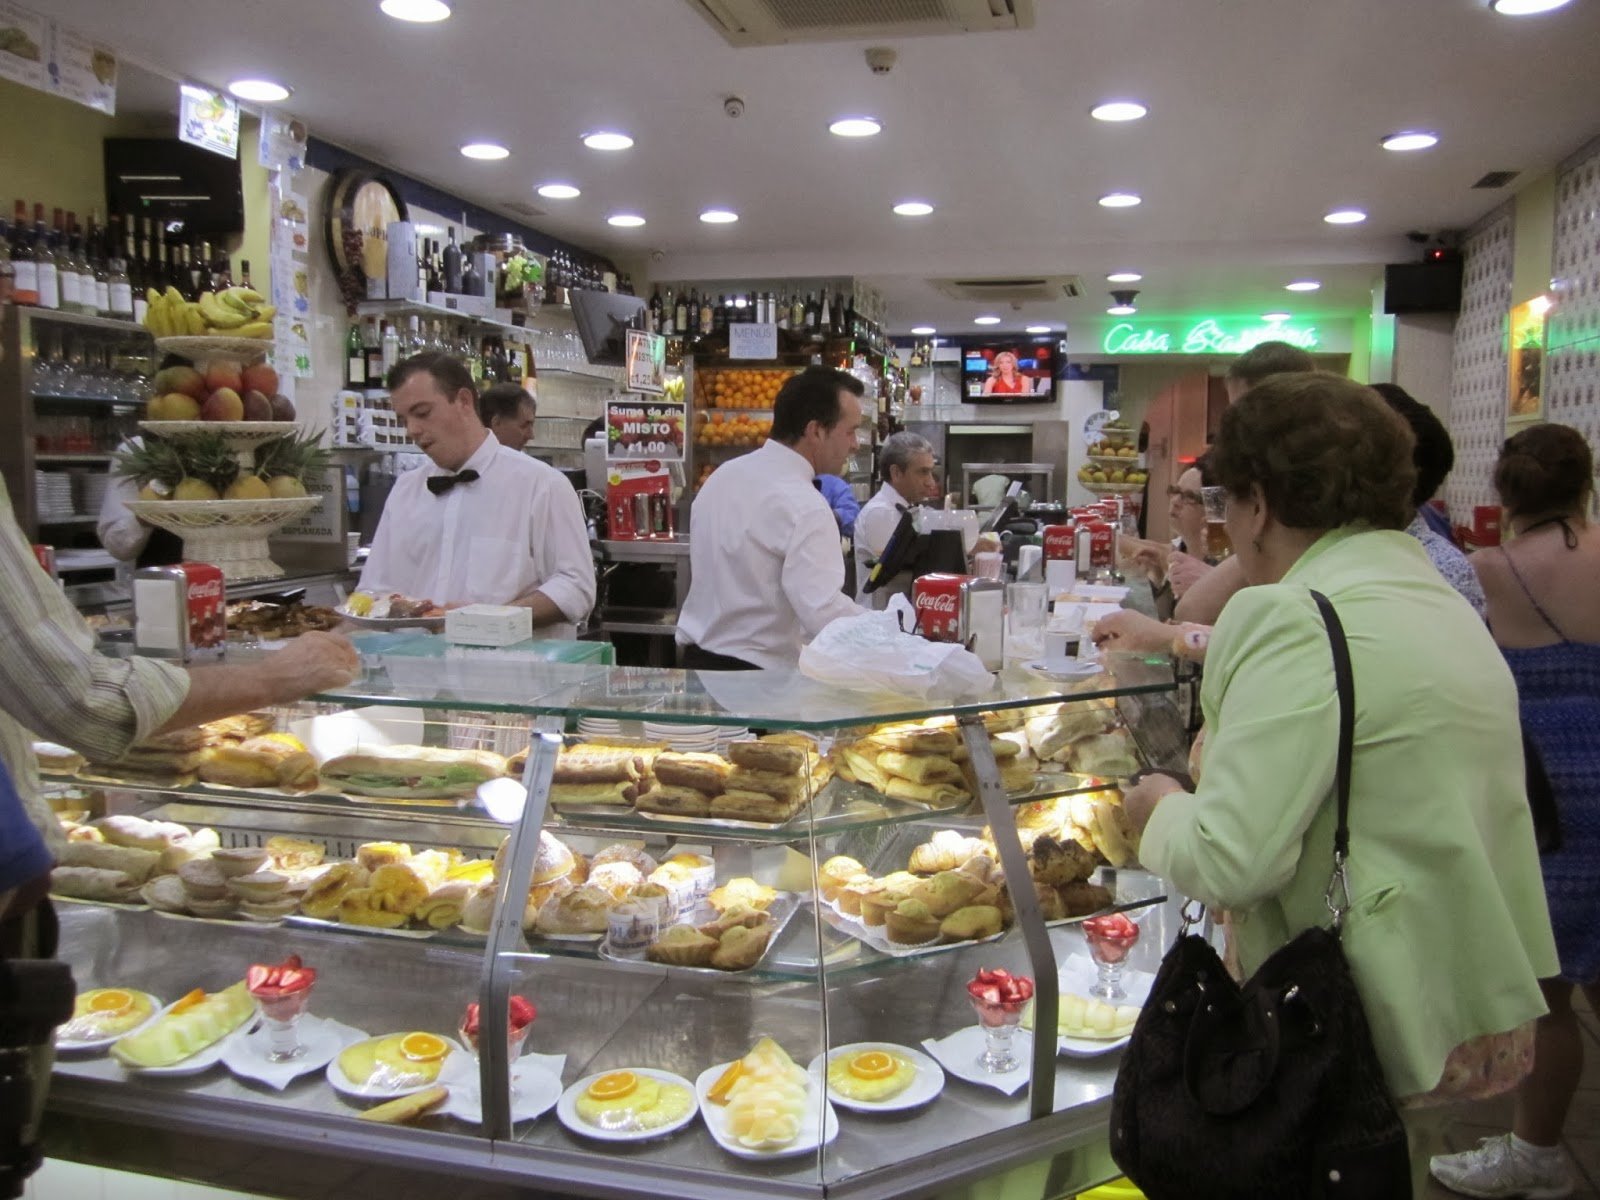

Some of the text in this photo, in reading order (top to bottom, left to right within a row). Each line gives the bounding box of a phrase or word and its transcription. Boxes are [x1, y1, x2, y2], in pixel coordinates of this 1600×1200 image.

[734, 327, 772, 338] MENUS
[1104, 323, 1170, 354] Casa
[622, 422, 671, 435] MISTO
